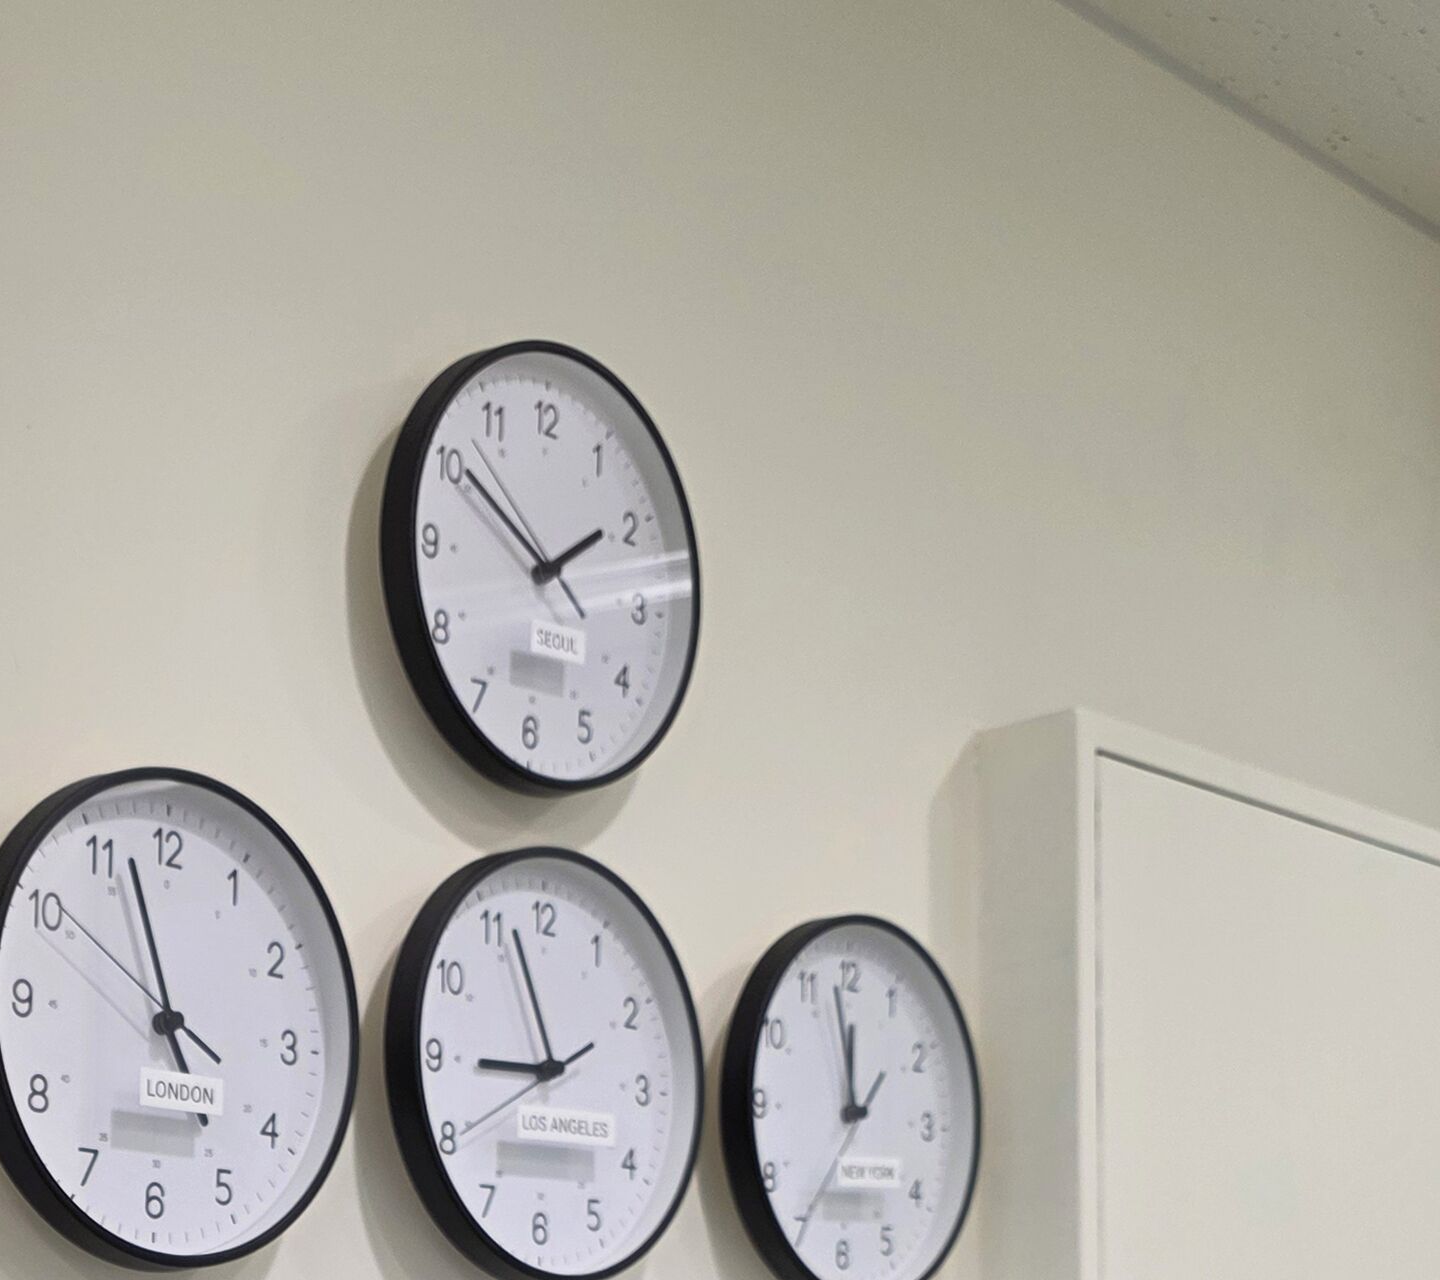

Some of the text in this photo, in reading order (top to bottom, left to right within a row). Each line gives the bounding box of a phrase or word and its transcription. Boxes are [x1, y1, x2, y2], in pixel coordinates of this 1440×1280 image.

[481, 402, 505, 442] 11
[534, 400, 559, 440] 12
[436, 445, 462, 485] 10
[592, 444, 603, 477] 1
[421, 523, 439, 559] 9
[622, 512, 639, 546] 2
[631, 594, 648, 625] 3
[431, 609, 450, 645] 8
[536, 629, 578, 655] SEOUL
[470, 678, 489, 712] 7
[614, 664, 631, 697] 4
[521, 715, 539, 749] 6
[577, 709, 593, 744] 5
[86, 835, 115, 878] 11
[153, 828, 184, 869] 12
[227, 869, 239, 906] 1
[28, 889, 61, 931] 10
[531, 900, 556, 937] 12
[480, 909, 503, 947] 11
[266, 941, 286, 979] 2
[591, 934, 602, 968] 1
[436, 958, 464, 995] 10
[799, 971, 817, 1004] 11
[839, 960, 861, 993] 12
[11, 978, 33, 1018] 9
[623, 997, 638, 1030] 2
[885, 988, 897, 1018] 1
[280, 1030, 299, 1065] 3
[762, 1018, 785, 1050] 10
[426, 1037, 443, 1072] 9
[912, 1042, 927, 1073] 2
[27, 1073, 49, 1113] 8
[147, 1079, 214, 1105] LONDON
[636, 1074, 650, 1107] 3
[752, 1087, 767, 1119] 9
[261, 1113, 280, 1148] 4
[439, 1120, 456, 1154] 8
[522, 1115, 609, 1138] LOS ANGELES
[921, 1112, 935, 1142] 3
[78, 1146, 99, 1186] 7
[622, 1149, 637, 1180] 4
[762, 1161, 777, 1192] 8
[144, 1181, 165, 1219] 6
[216, 1169, 233, 1206] 5
[479, 1184, 495, 1218] 7
[909, 1178, 924, 1201] 4
[532, 1212, 549, 1245] 6
[586, 1198, 602, 1231] 5
[835, 1240, 850, 1271] 6
[880, 1224, 894, 1256] 5
